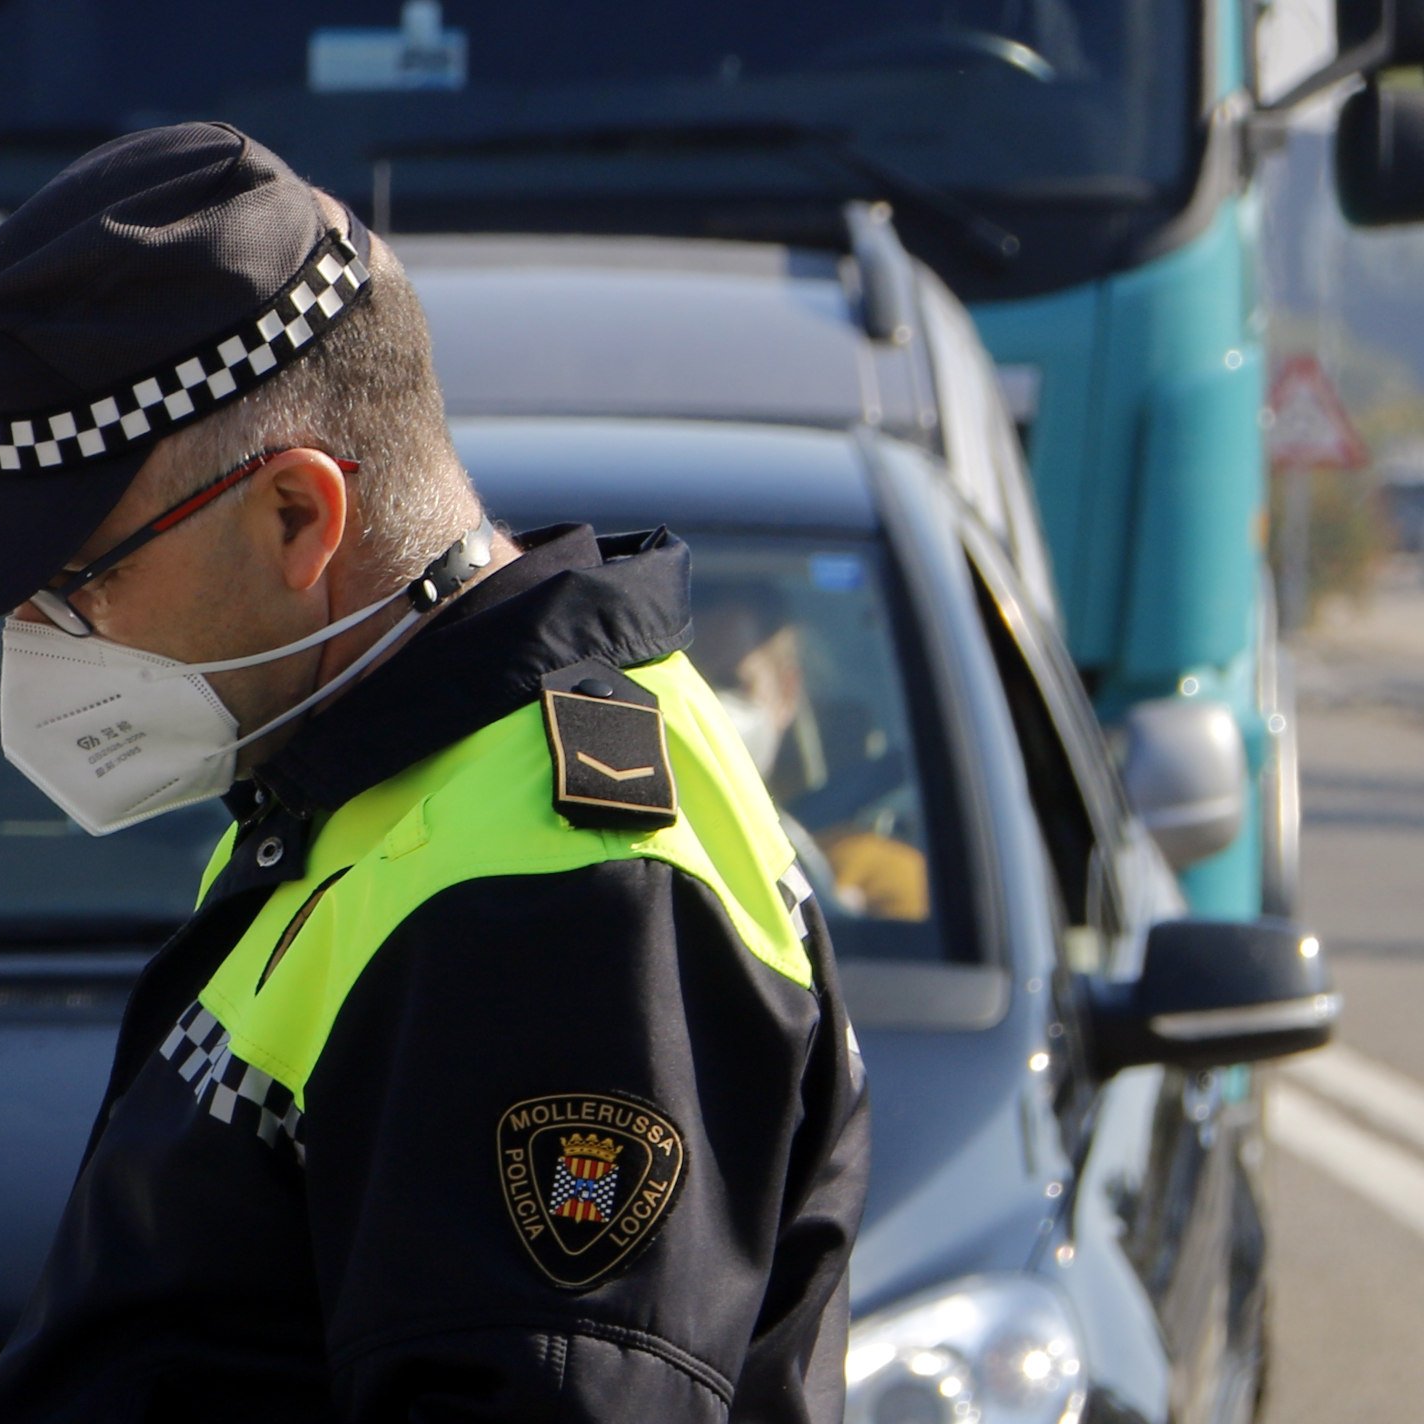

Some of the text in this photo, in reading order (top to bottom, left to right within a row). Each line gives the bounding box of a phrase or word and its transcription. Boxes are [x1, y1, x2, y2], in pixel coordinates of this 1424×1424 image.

[509, 1102, 674, 1156] MOLLERUSSA
[505, 1148, 545, 1240] POLICIA
[609, 1180, 668, 1247] LOCAL
